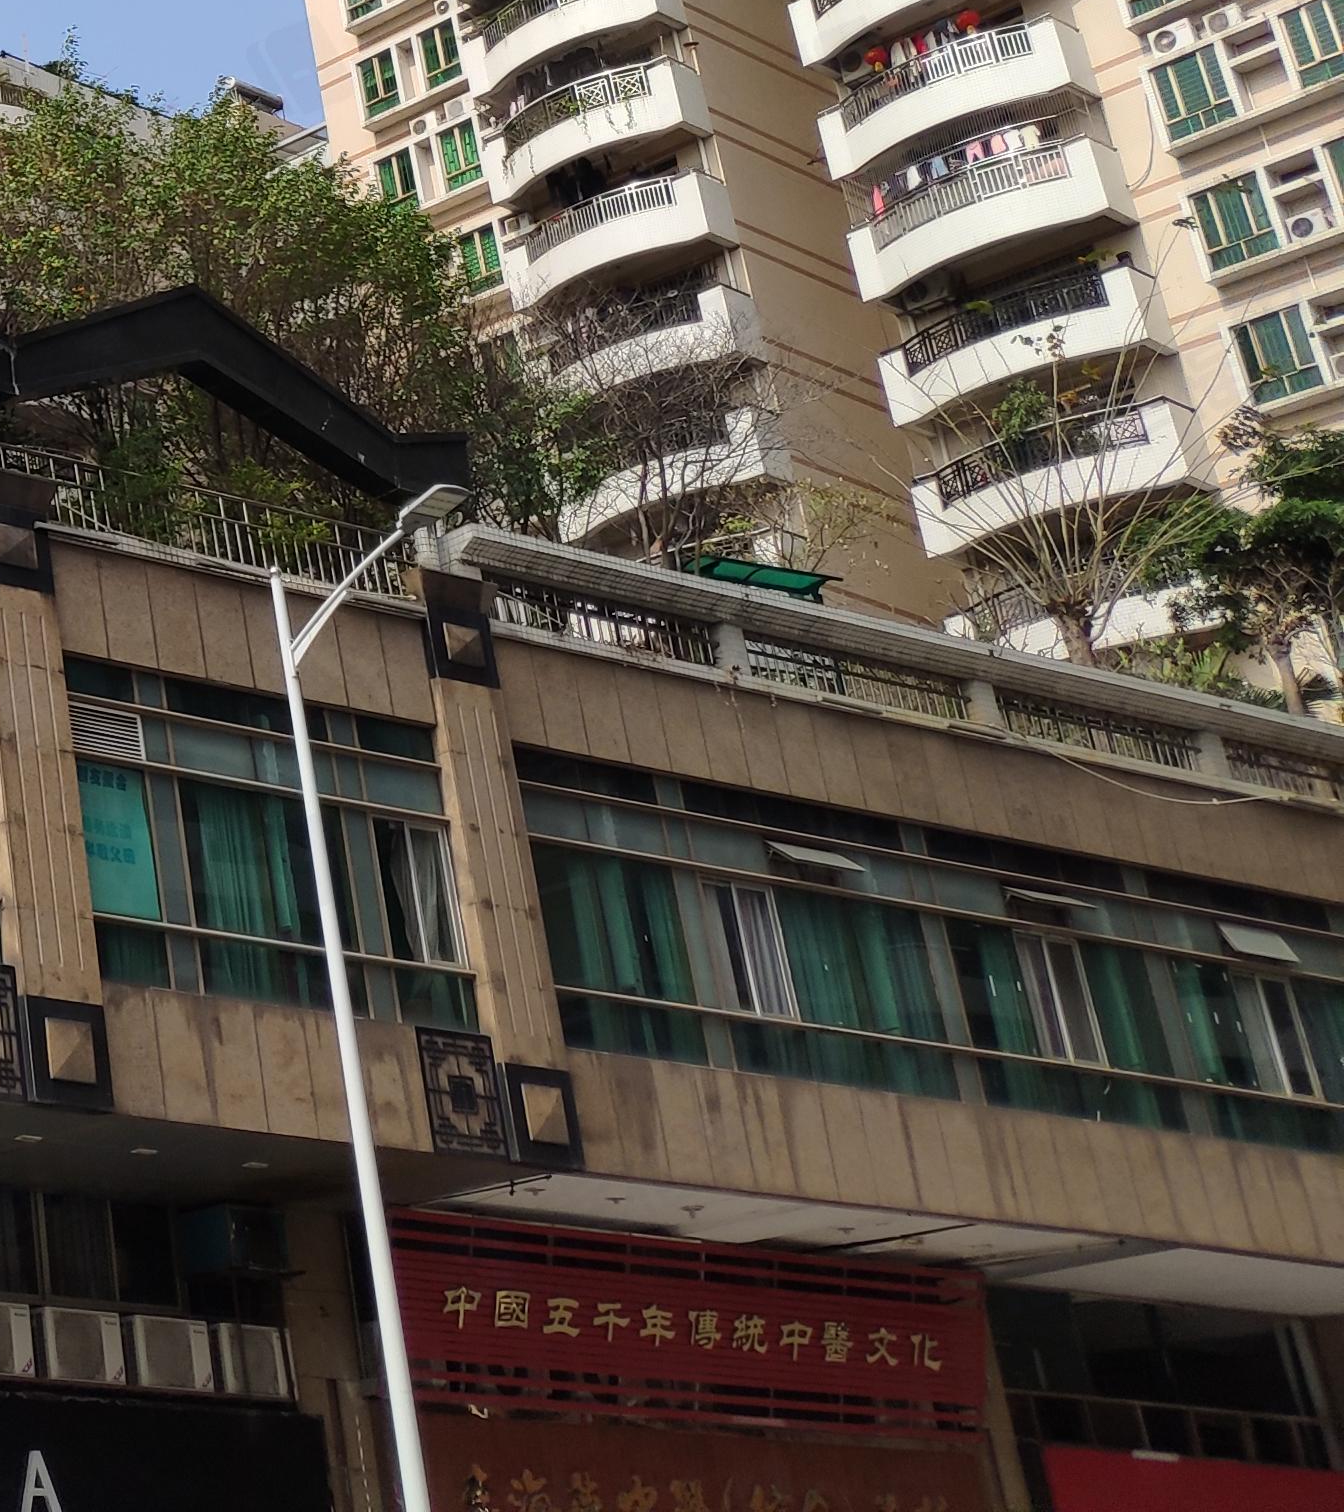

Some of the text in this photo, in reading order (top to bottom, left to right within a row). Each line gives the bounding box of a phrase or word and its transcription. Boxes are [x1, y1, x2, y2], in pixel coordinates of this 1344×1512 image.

[442, 1285, 942, 1372] 中國五千年傳統中醫文化
